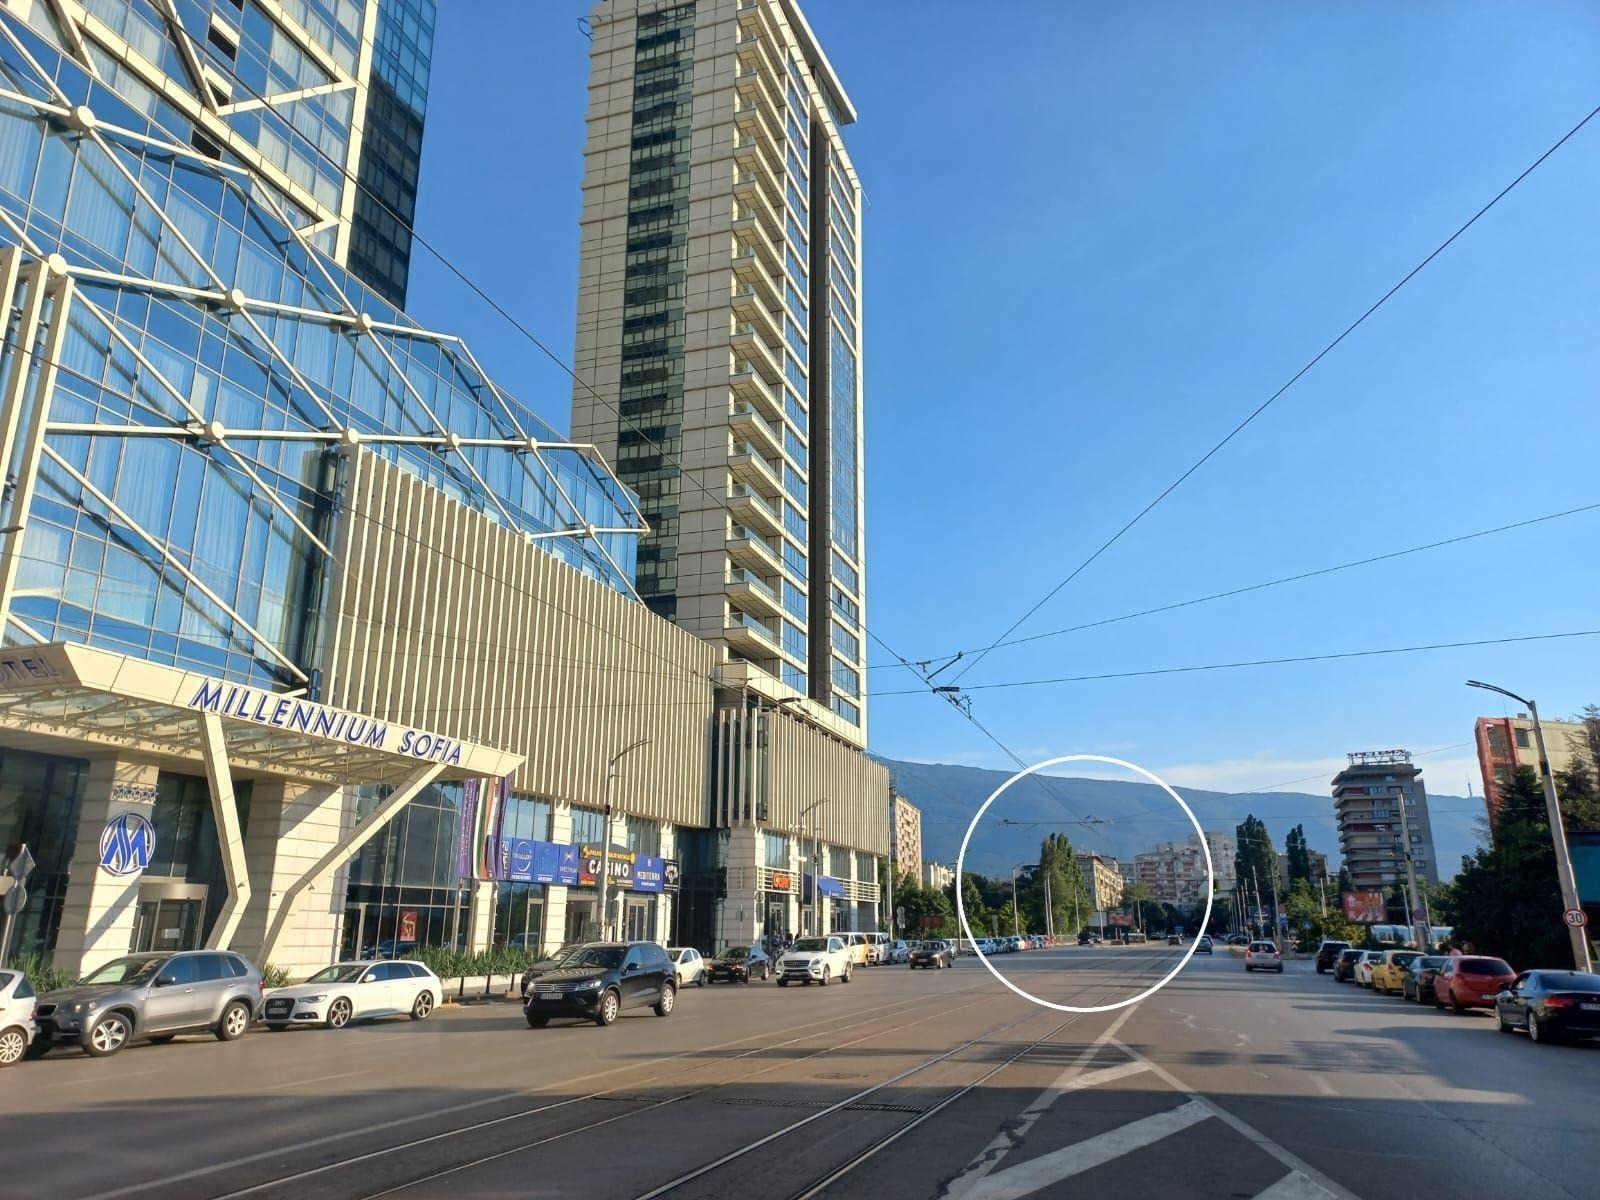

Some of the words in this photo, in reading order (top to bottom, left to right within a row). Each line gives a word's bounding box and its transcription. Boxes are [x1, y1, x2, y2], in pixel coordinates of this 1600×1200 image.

[188, 677, 388, 748] MILLENNIUM
[398, 730, 462, 765] SOFIA
[1568, 912, 1583, 924] 30
